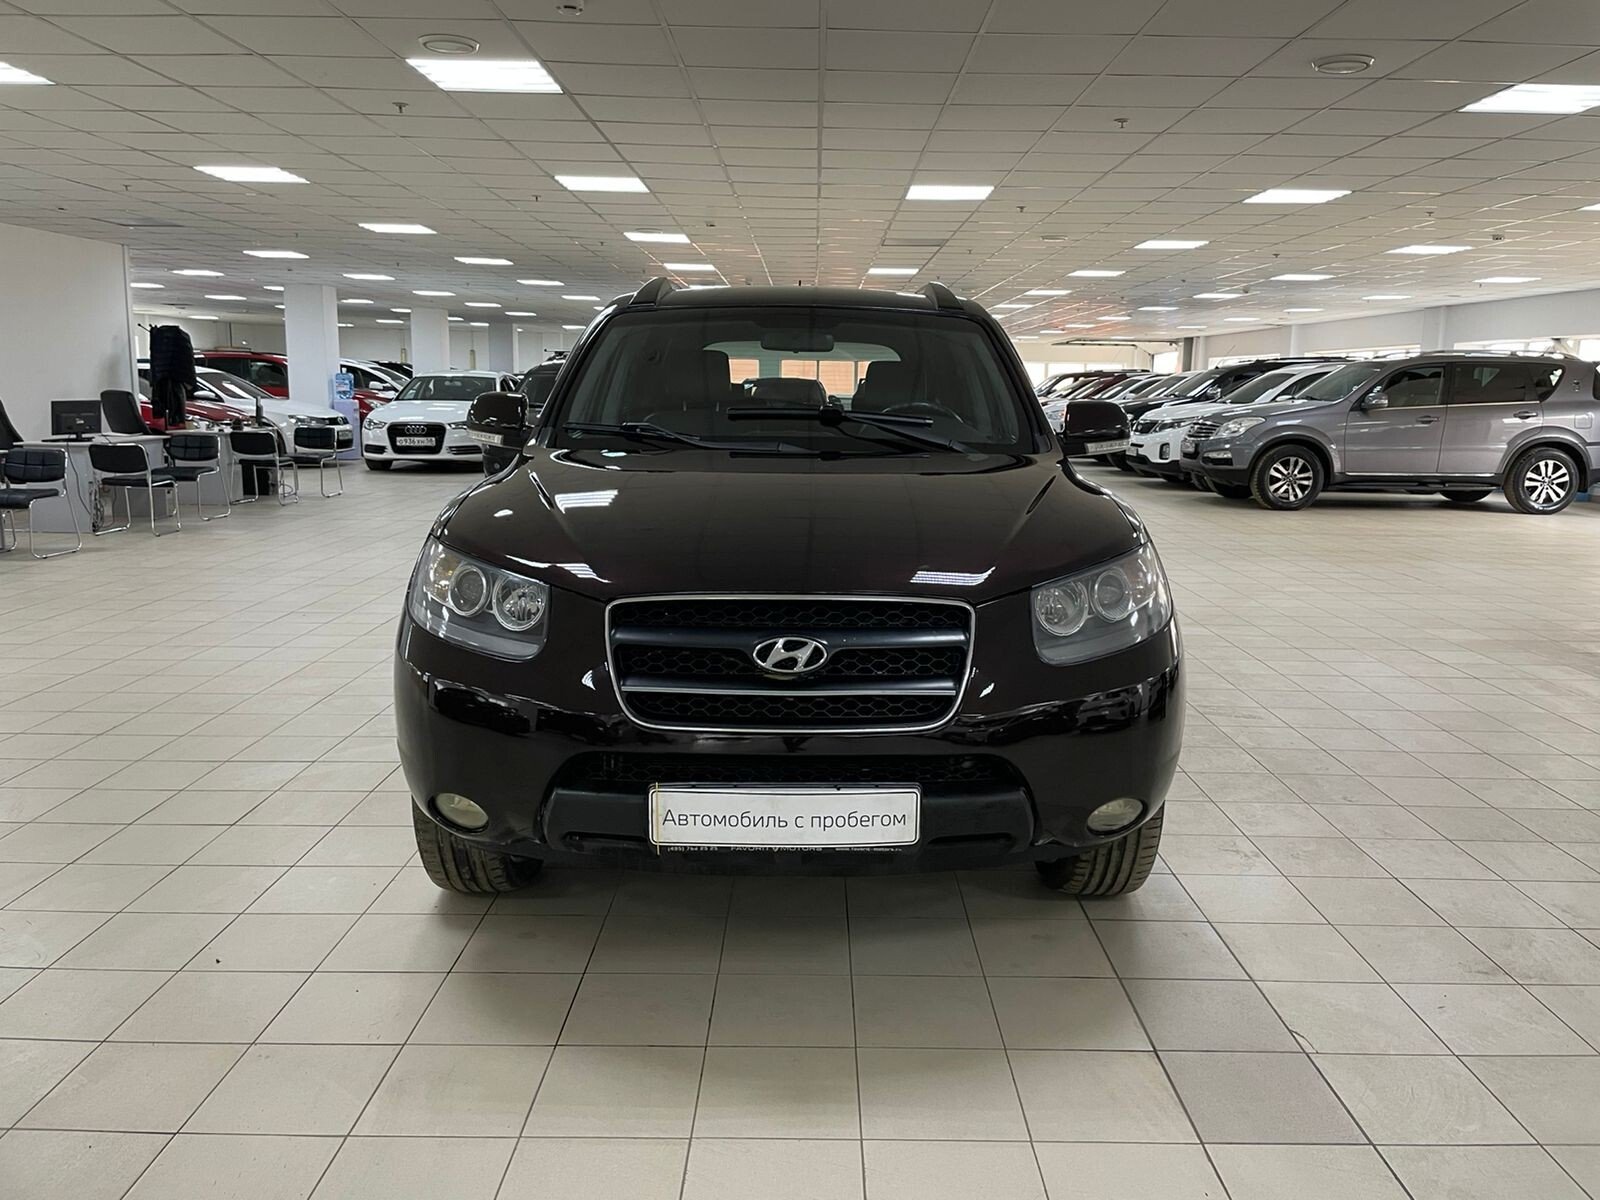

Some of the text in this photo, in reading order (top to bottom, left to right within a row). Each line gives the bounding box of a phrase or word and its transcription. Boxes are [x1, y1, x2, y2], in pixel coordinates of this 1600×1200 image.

[662, 809, 906, 831] Автомобиль с пробегом
